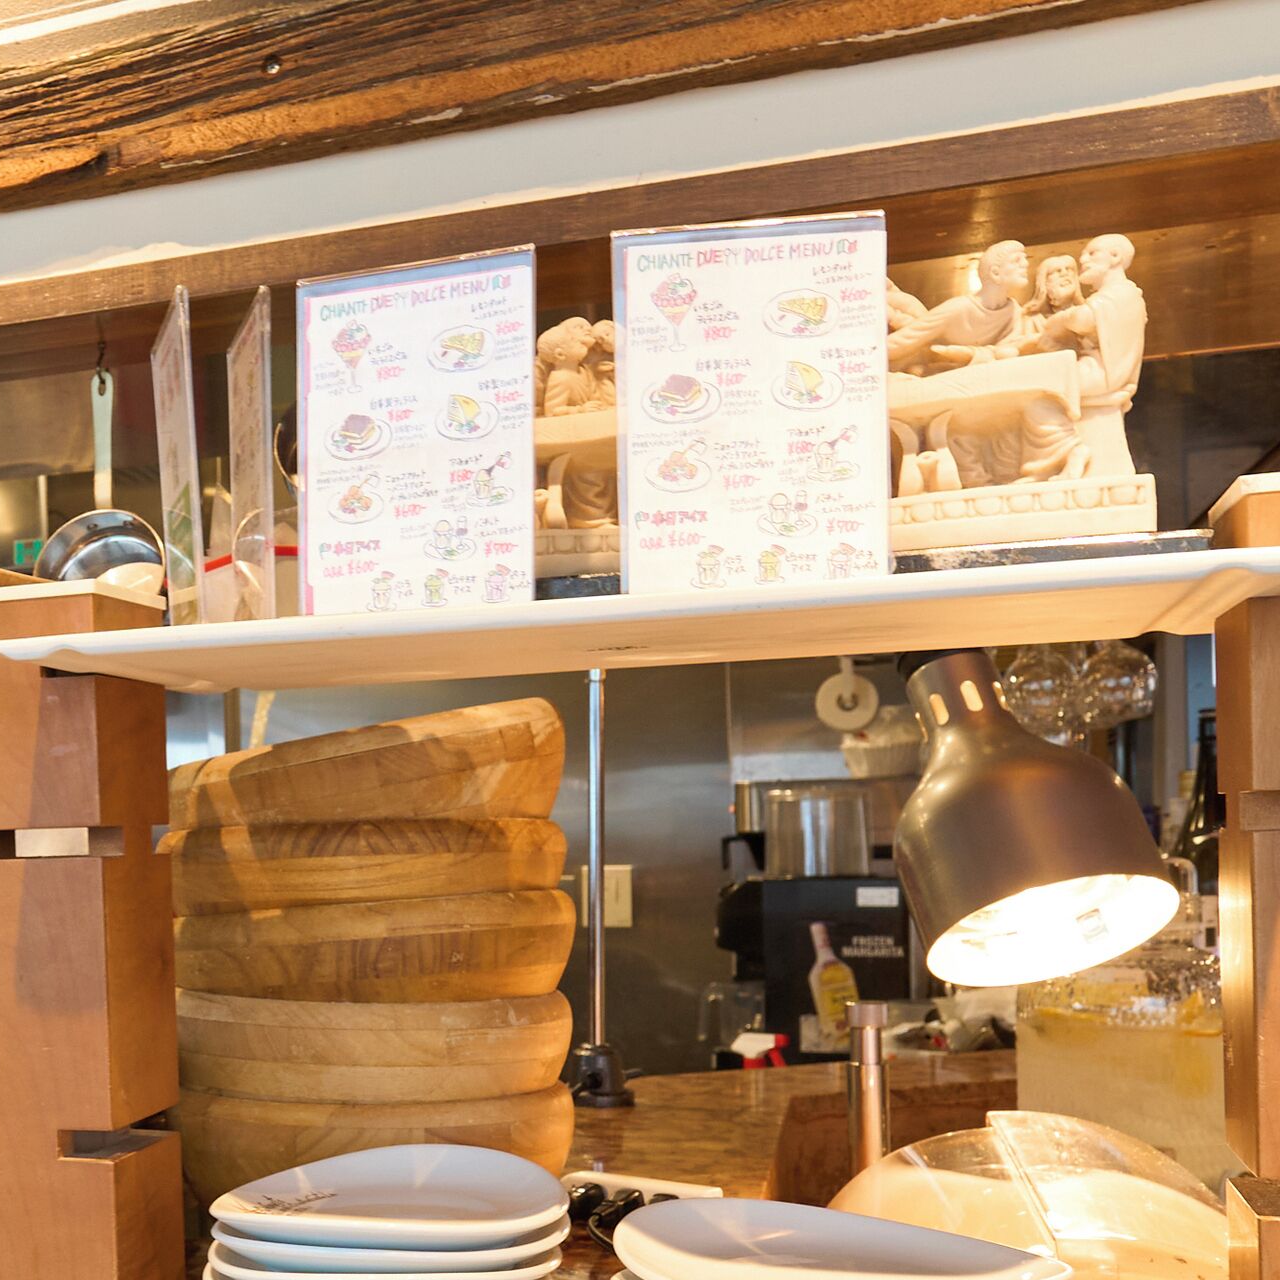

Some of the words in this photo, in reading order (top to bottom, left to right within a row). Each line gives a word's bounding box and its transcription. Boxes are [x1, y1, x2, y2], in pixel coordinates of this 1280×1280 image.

[745, 245, 784, 265] DOLCE
[789, 240, 833, 260] MENU
[411, 286, 447, 308] DOLCE
[449, 278, 489, 298] MENU
